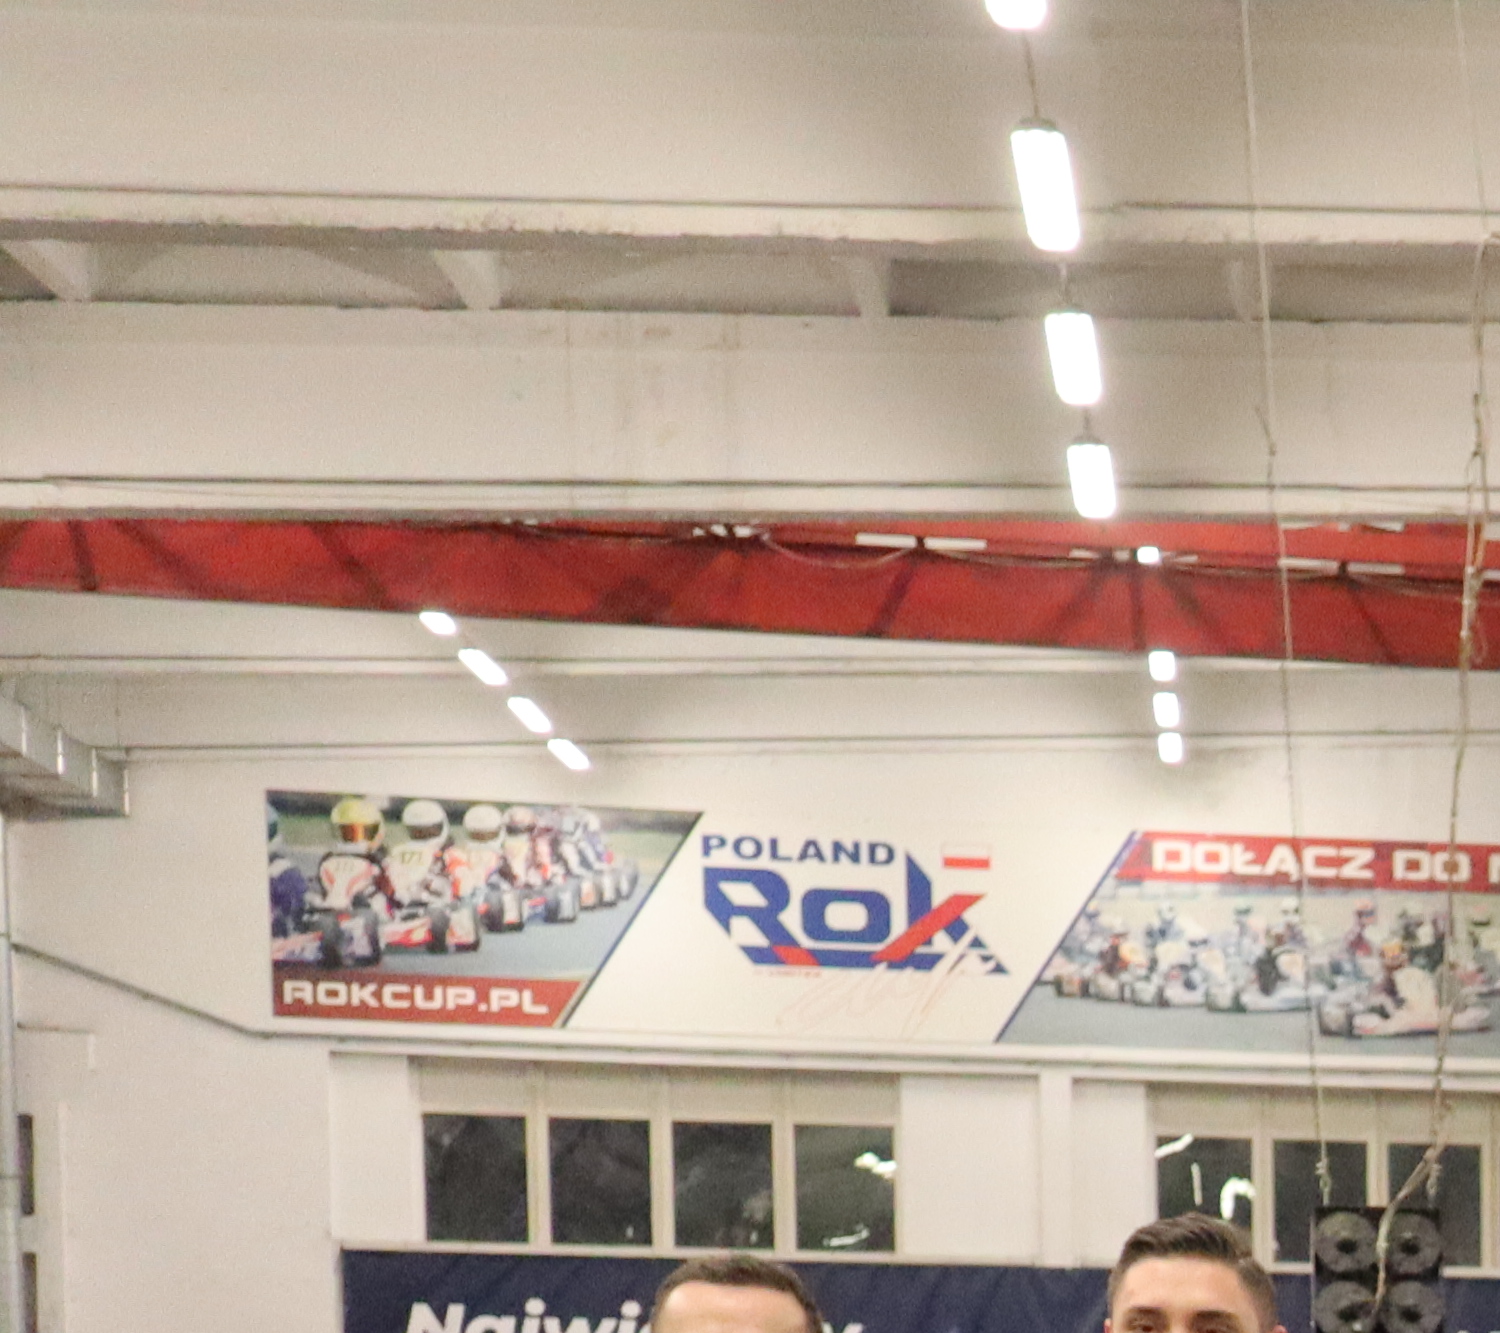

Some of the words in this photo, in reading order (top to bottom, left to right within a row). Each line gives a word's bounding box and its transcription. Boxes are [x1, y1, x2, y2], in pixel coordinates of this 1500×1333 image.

[701, 834, 895, 866] POLAND
[1152, 839, 1375, 883] DOŁĄCZ
[1391, 849, 1472, 882] DO
[282, 979, 550, 1015] ROKCUP.PL
